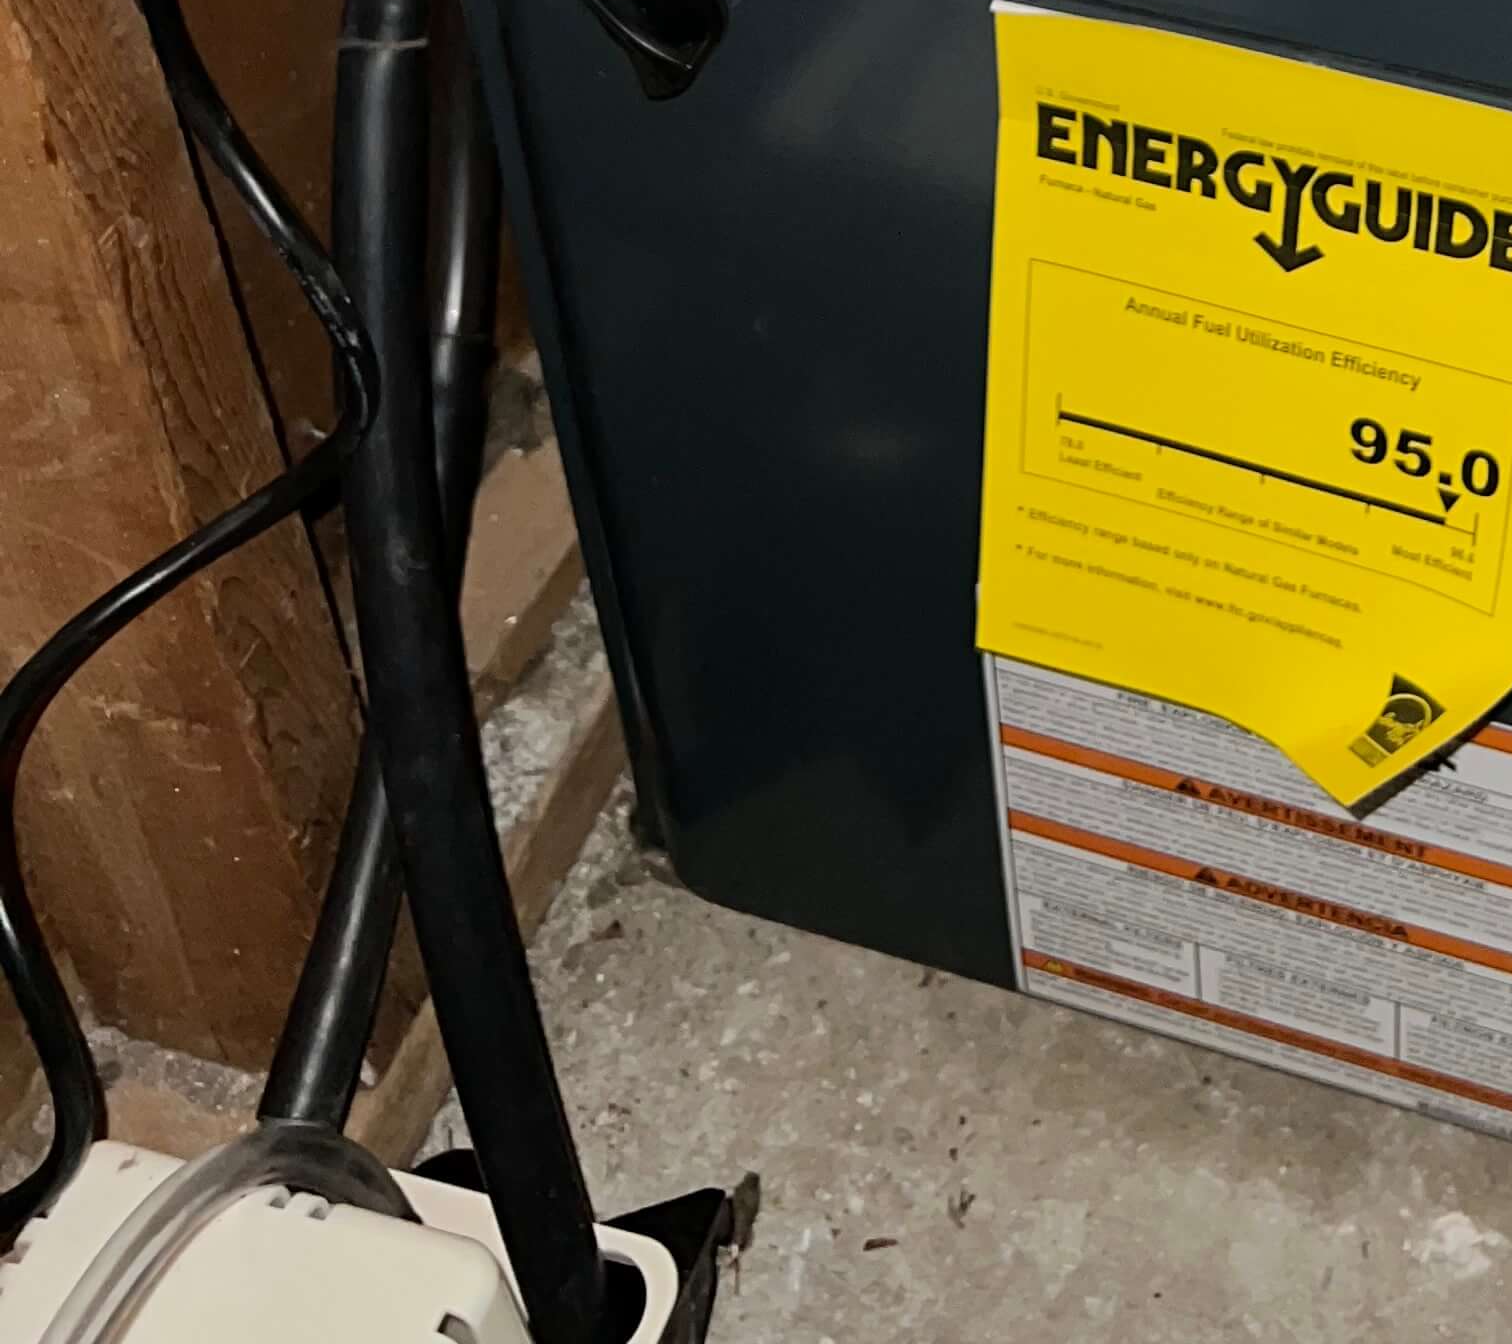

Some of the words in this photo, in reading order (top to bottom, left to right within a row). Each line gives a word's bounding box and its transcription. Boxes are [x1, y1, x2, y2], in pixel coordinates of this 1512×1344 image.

[1123, 295, 1188, 326] Annual
[1191, 312, 1232, 338] Fuel
[1234, 324, 1325, 363] Utilization
[1329, 349, 1422, 392] Efficiency
[1349, 416, 1501, 498] 95.0
[1227, 876, 1410, 939] ADVERTENCIA
